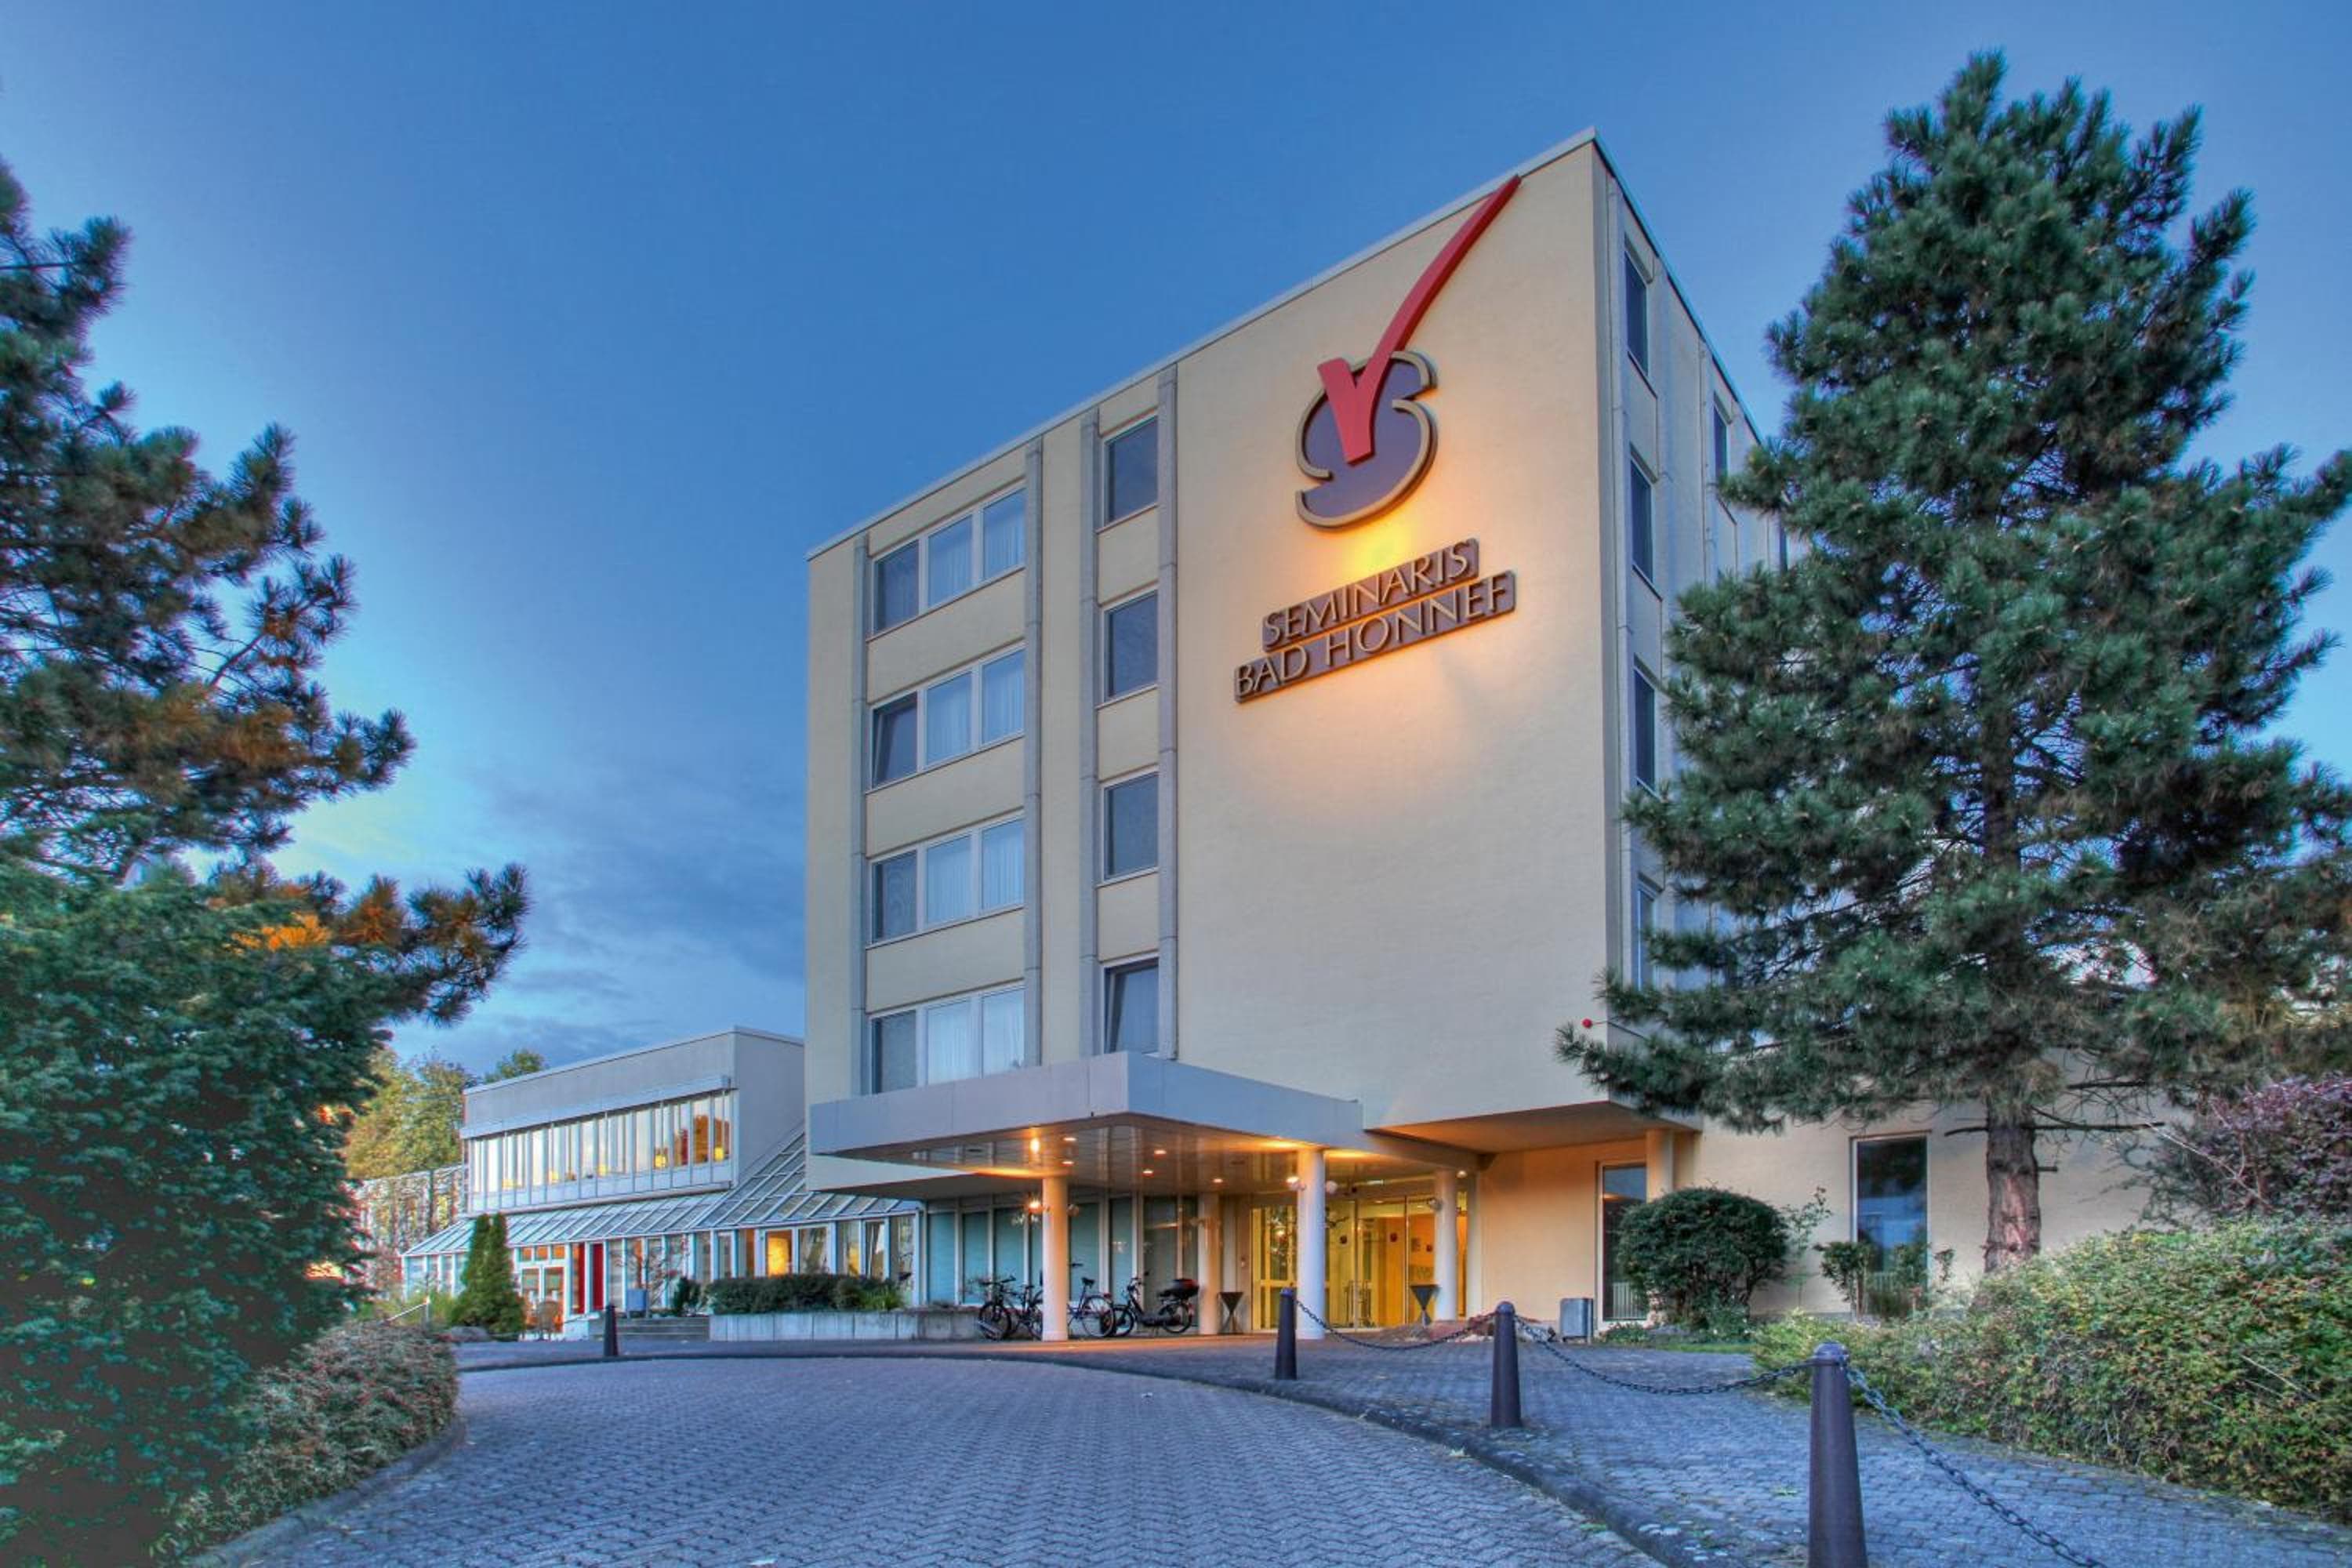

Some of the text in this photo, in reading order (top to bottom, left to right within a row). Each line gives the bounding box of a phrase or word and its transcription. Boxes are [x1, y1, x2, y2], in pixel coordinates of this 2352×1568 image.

[1237, 573, 1508, 696] BAD HONNEF
[1264, 539, 1469, 647] SEMINARIS
